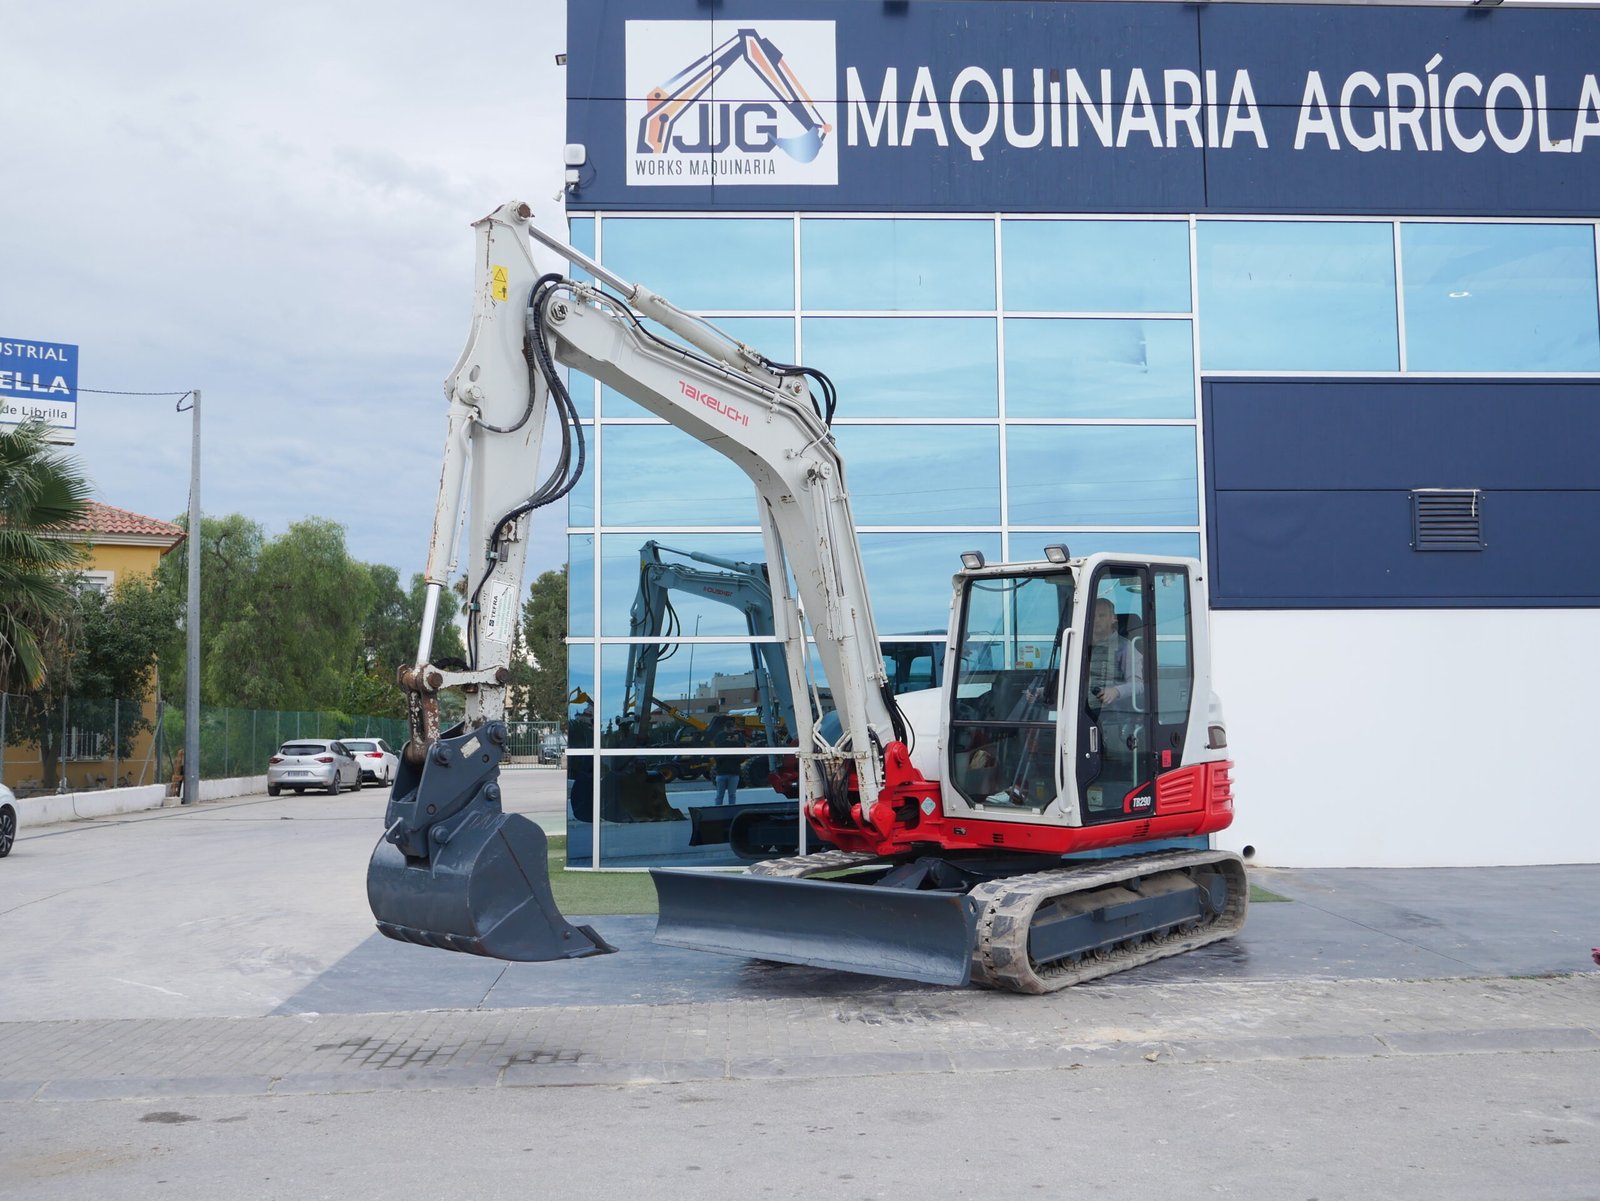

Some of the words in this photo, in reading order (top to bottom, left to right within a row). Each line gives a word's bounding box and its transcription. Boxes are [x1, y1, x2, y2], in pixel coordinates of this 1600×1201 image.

[846, 66, 1269, 161] MAQUINARIA
[635, 159, 683, 176] WORKS
[689, 159, 776, 177] MAQUINARIA
[0, 342, 68, 361] STRIAL
[22, 405, 68, 419] Librilla
[1132, 796, 1151, 807] TB290
